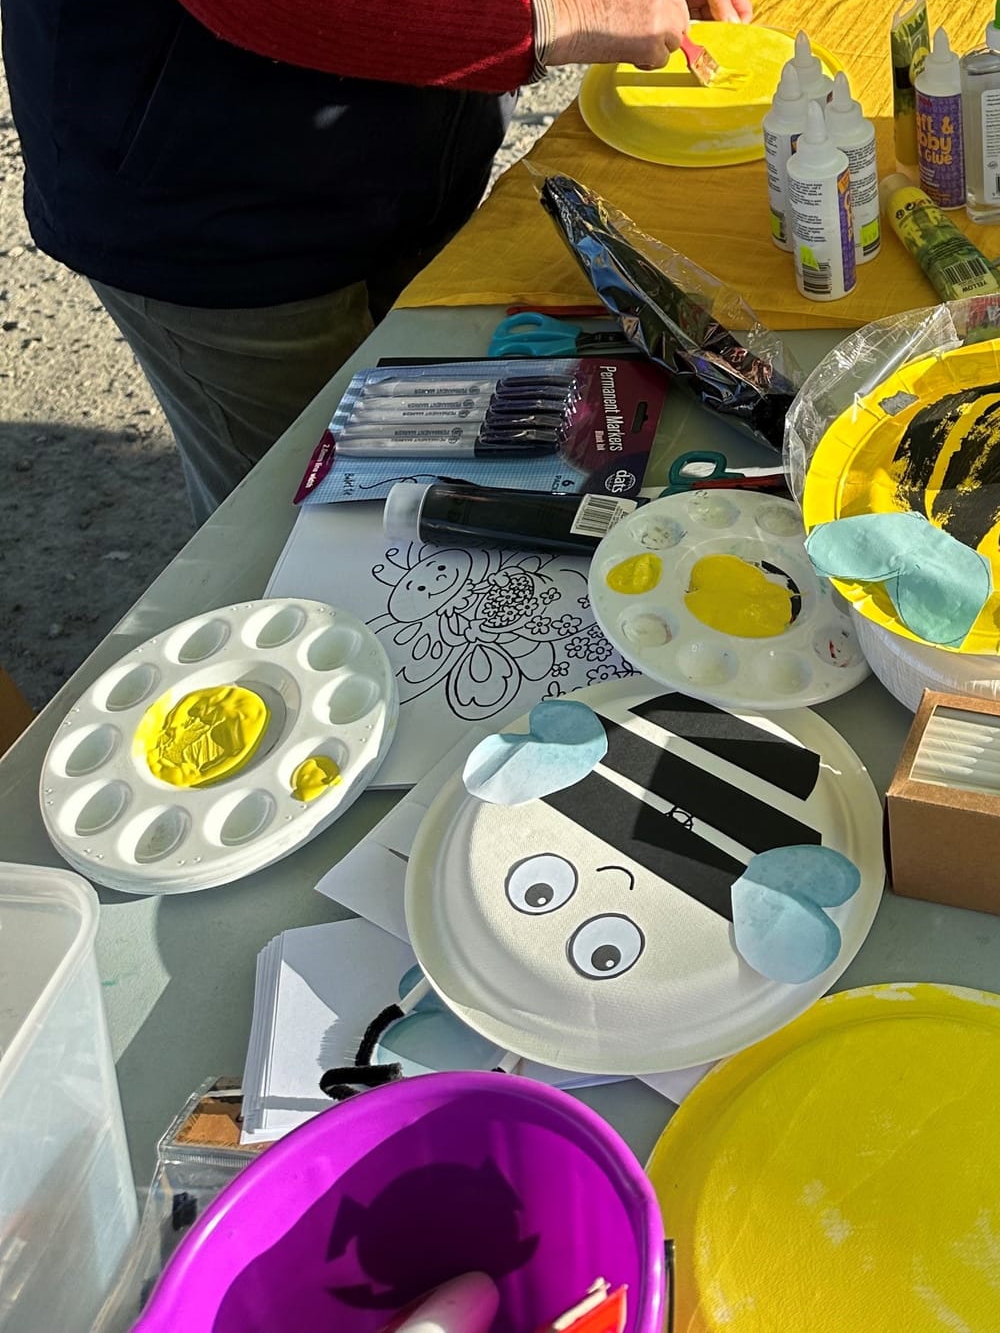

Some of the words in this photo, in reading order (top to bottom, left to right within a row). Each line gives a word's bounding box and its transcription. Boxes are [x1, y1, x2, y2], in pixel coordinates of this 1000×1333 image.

[924, 148, 953, 166] Glue
[962, 279, 987, 293] YELLOW
[600, 366, 621, 414] Permanent
[606, 416, 626, 452] Markers
[561, 479, 575, 487] 6
[611, 469, 630, 493] dats
